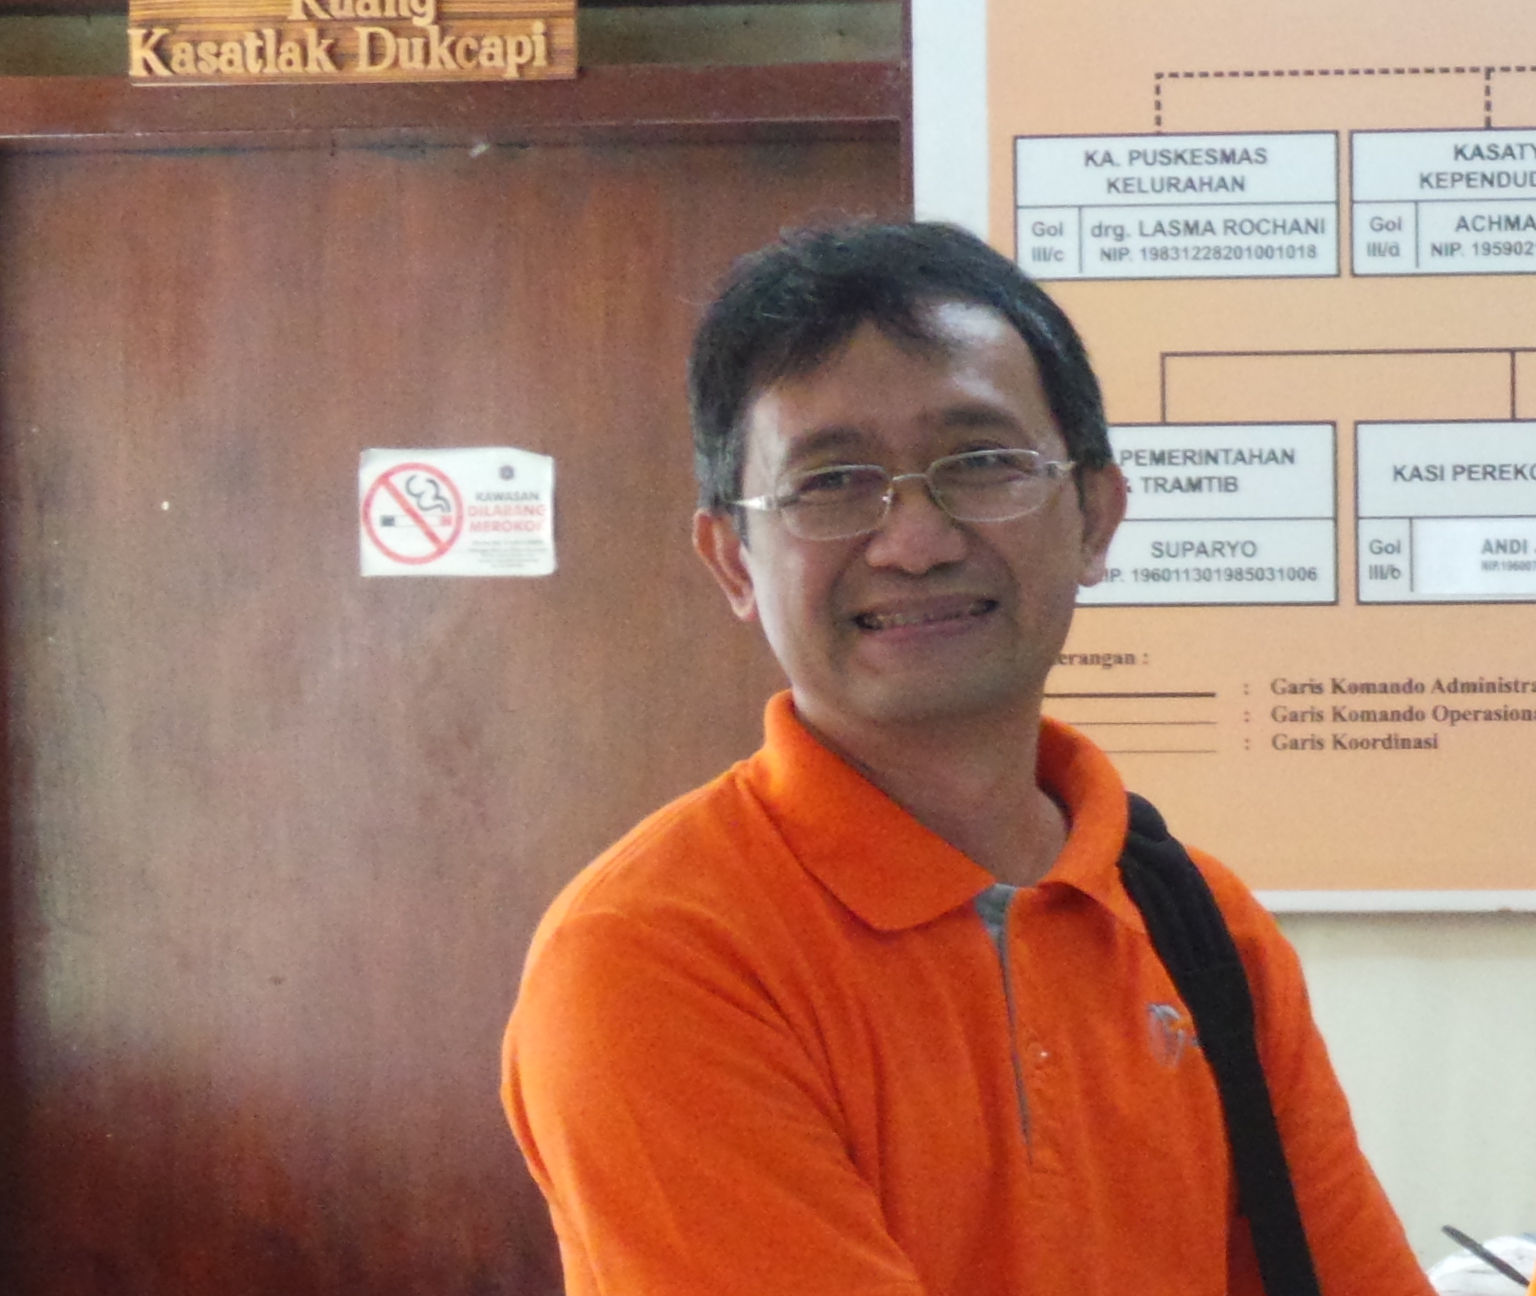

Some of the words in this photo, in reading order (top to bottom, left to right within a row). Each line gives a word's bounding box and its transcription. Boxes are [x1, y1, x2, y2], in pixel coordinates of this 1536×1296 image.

[129, 28, 337, 76] Kasatlak
[357, 22, 547, 77] Dukcapi
[1085, 151, 1119, 167] KA.
[1129, 148, 1267, 166] PUSKESMAS
[1107, 176, 1245, 194] KELURAHAN
[1032, 221, 1064, 237] Gol
[1091, 222, 1130, 242] drg.
[1139, 220, 1216, 237] LASMA
[1224, 218, 1325, 236] ROCHANI
[1370, 216, 1402, 232] Gol
[1100, 247, 1131, 261] NIP.
[1431, 243, 1463, 256] NIP.
[1120, 448, 1296, 467] PEMERINTAHAN
[1393, 465, 1444, 482] KASI
[1142, 476, 1238, 493] TRAMTIB
[476, 491, 540, 502] KAWASAN
[1152, 540, 1257, 558] SUPARYO
[1369, 539, 1401, 555] Gol
[1482, 539, 1528, 554] ANDI
[1271, 679, 1324, 695] Garis
[1331, 678, 1425, 694] Komando
[1271, 706, 1324, 723] Garis
[1332, 706, 1426, 722] Komando
[1272, 734, 1325, 750] Garis
[1333, 733, 1438, 750] Koordinasi
